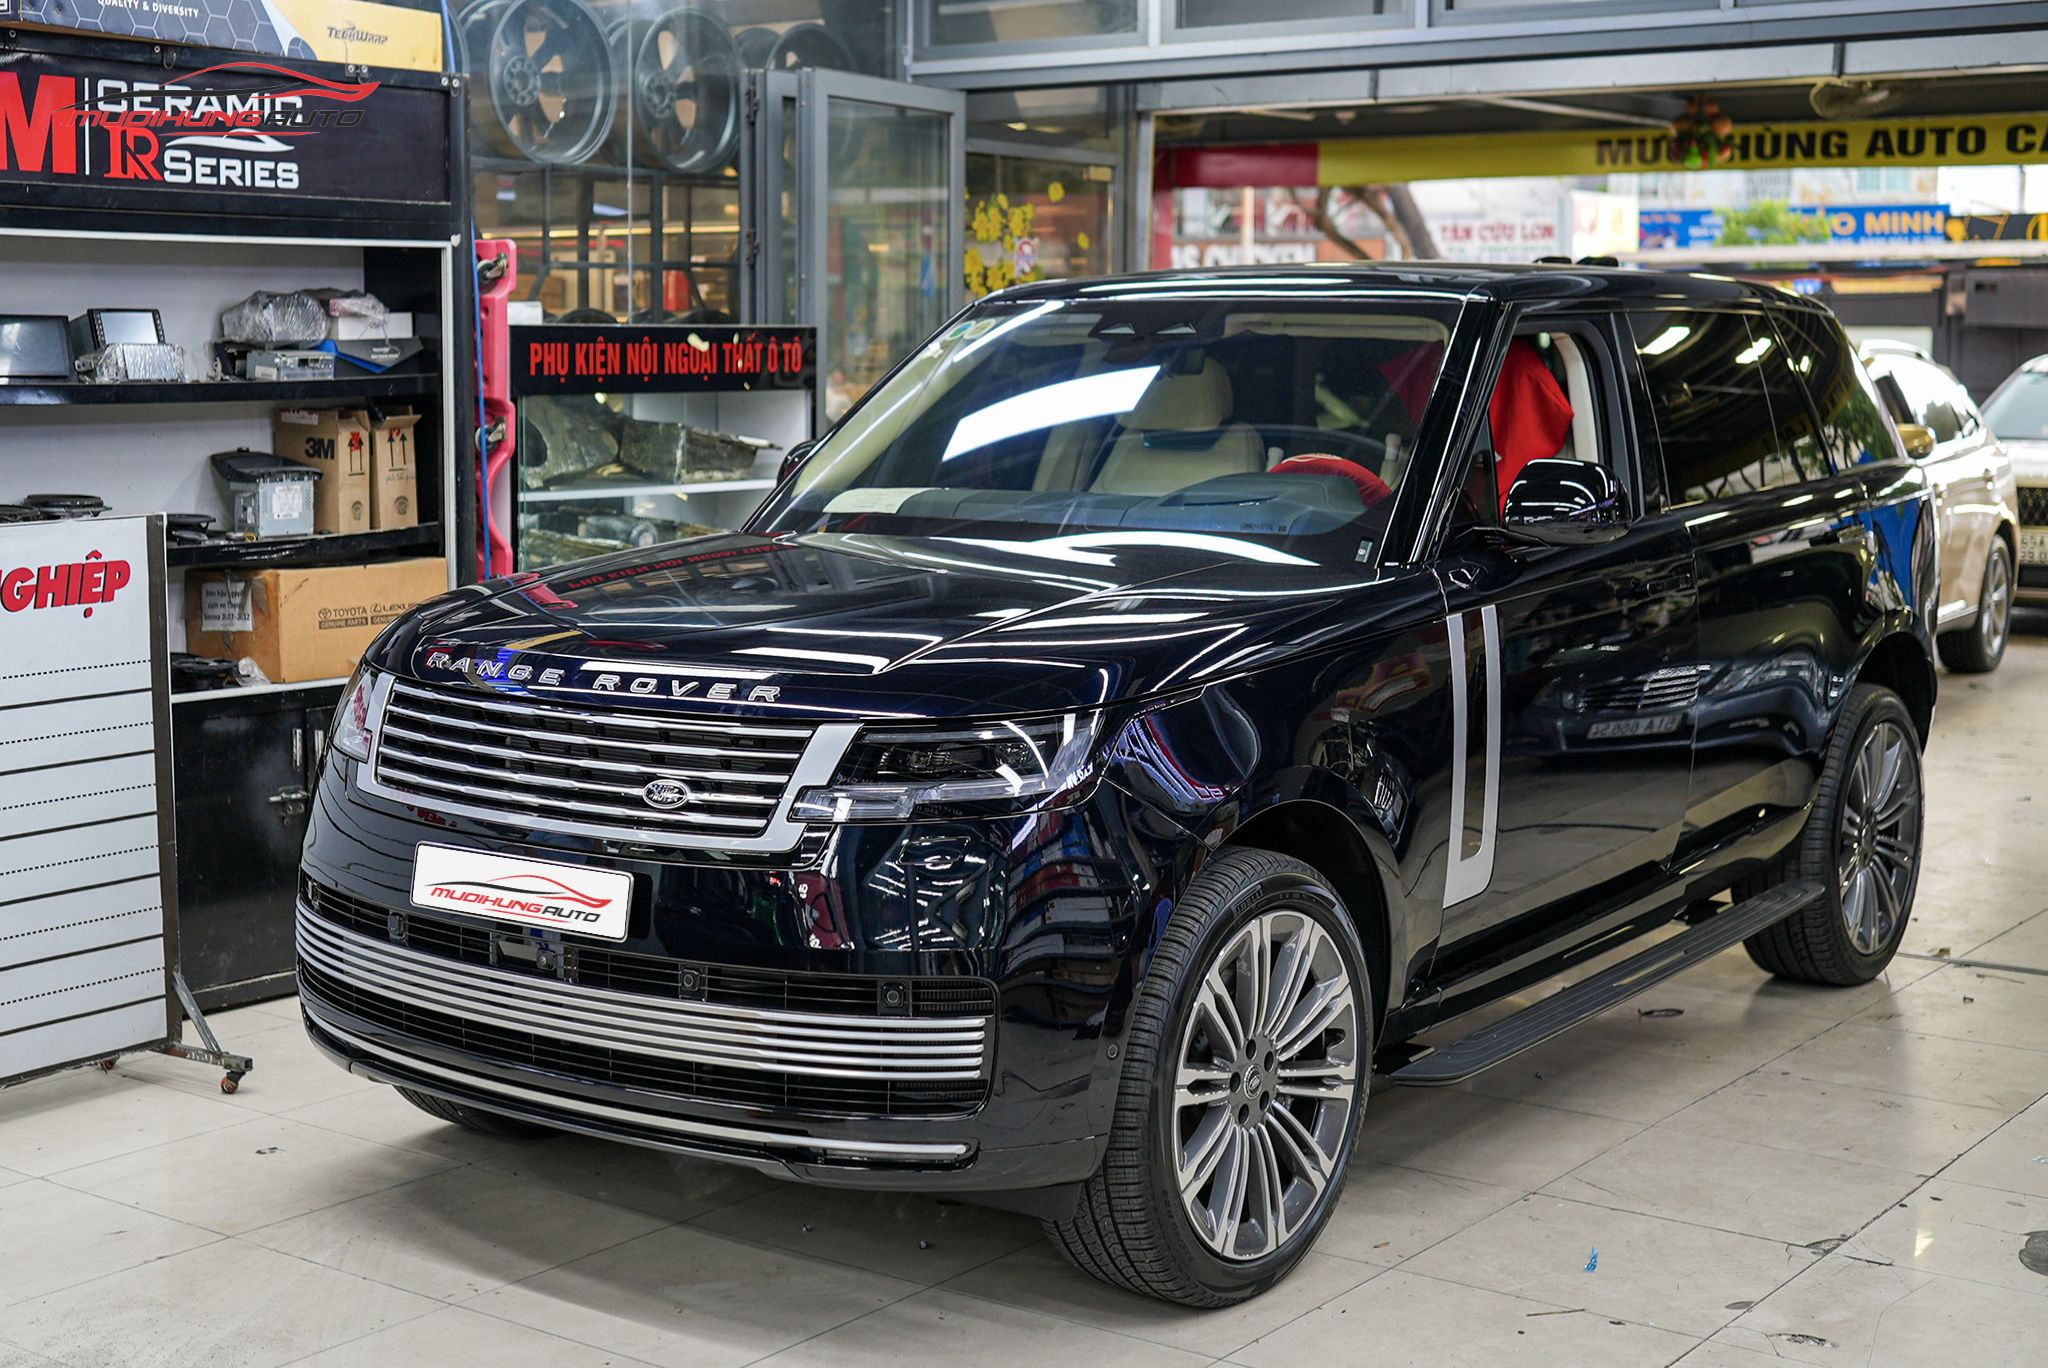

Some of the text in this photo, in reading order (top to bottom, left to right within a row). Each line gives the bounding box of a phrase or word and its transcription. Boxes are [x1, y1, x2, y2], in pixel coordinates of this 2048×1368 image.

[142, 2, 150, 11] &
[152, 3, 199, 18] DIVERSITY
[1865, 124, 1988, 158] AUTO
[2006, 122, 2048, 156] C
[1864, 210, 1945, 236] MINH
[530, 332, 802, 383] PHỤ KIỆN NỘI NGOẠI THẤT Ô TÔ
[304, 436, 335, 460] 3M
[0, 549, 131, 618] GHIỆP
[333, 606, 368, 618] TOYOTA
[426, 651, 782, 702] RANGE ROVER
